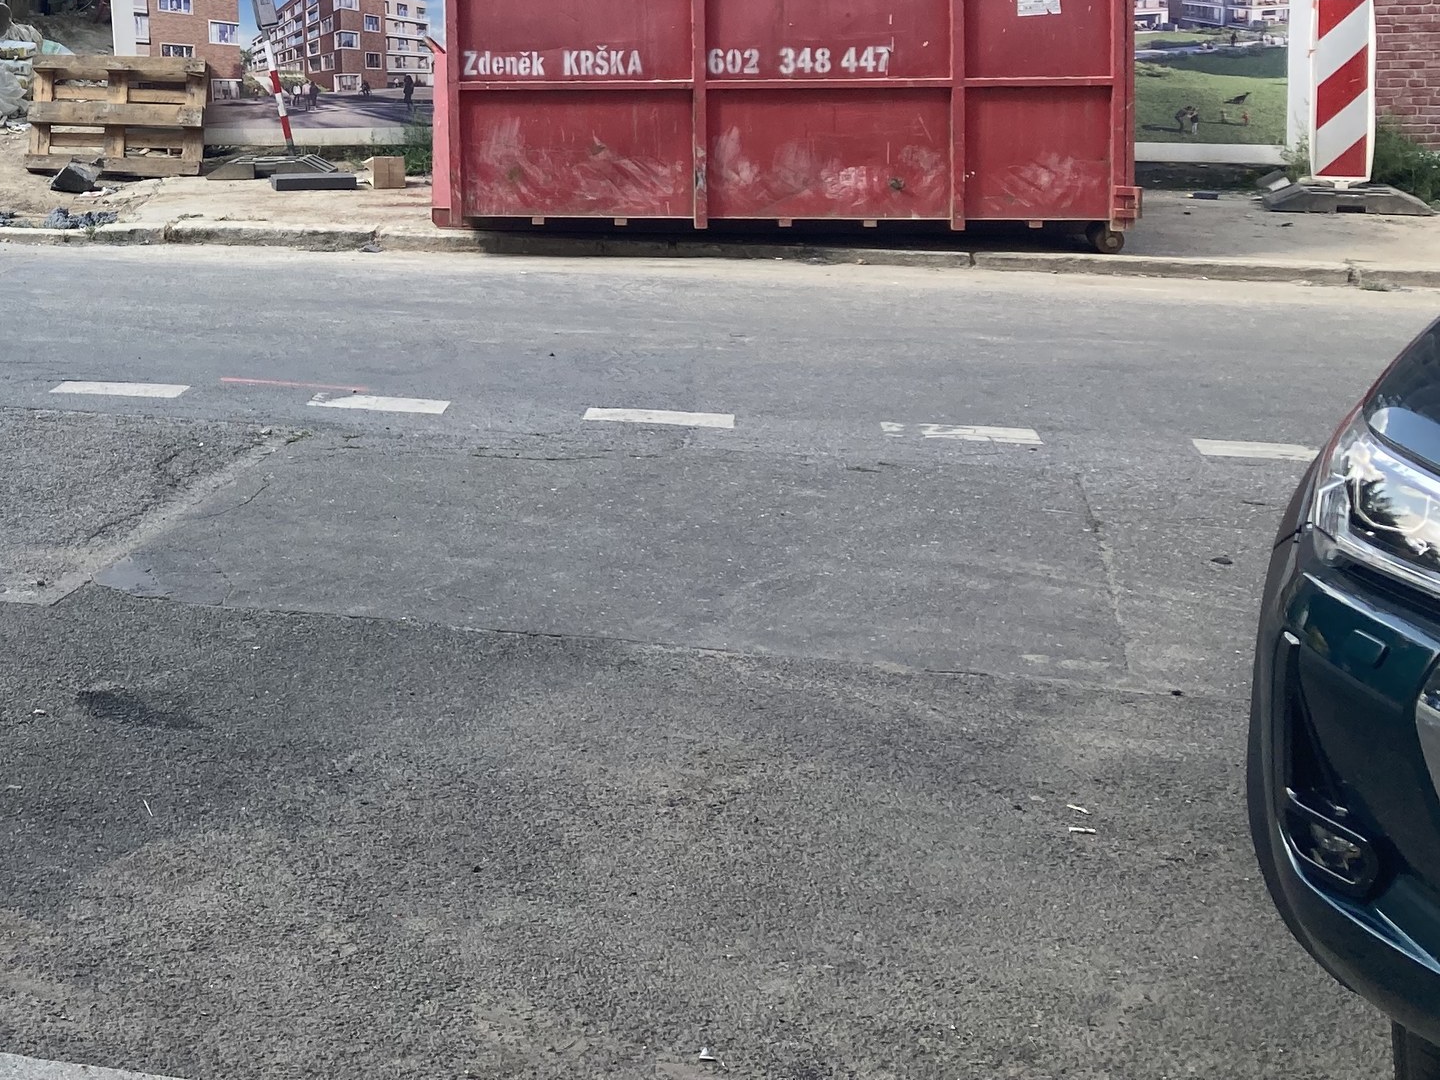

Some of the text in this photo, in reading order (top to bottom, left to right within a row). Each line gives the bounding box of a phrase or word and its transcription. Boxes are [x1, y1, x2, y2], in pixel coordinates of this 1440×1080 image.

[463, 45, 643, 76] Zdeněk KRŠKA
[709, 46, 890, 75] 602 348 447
